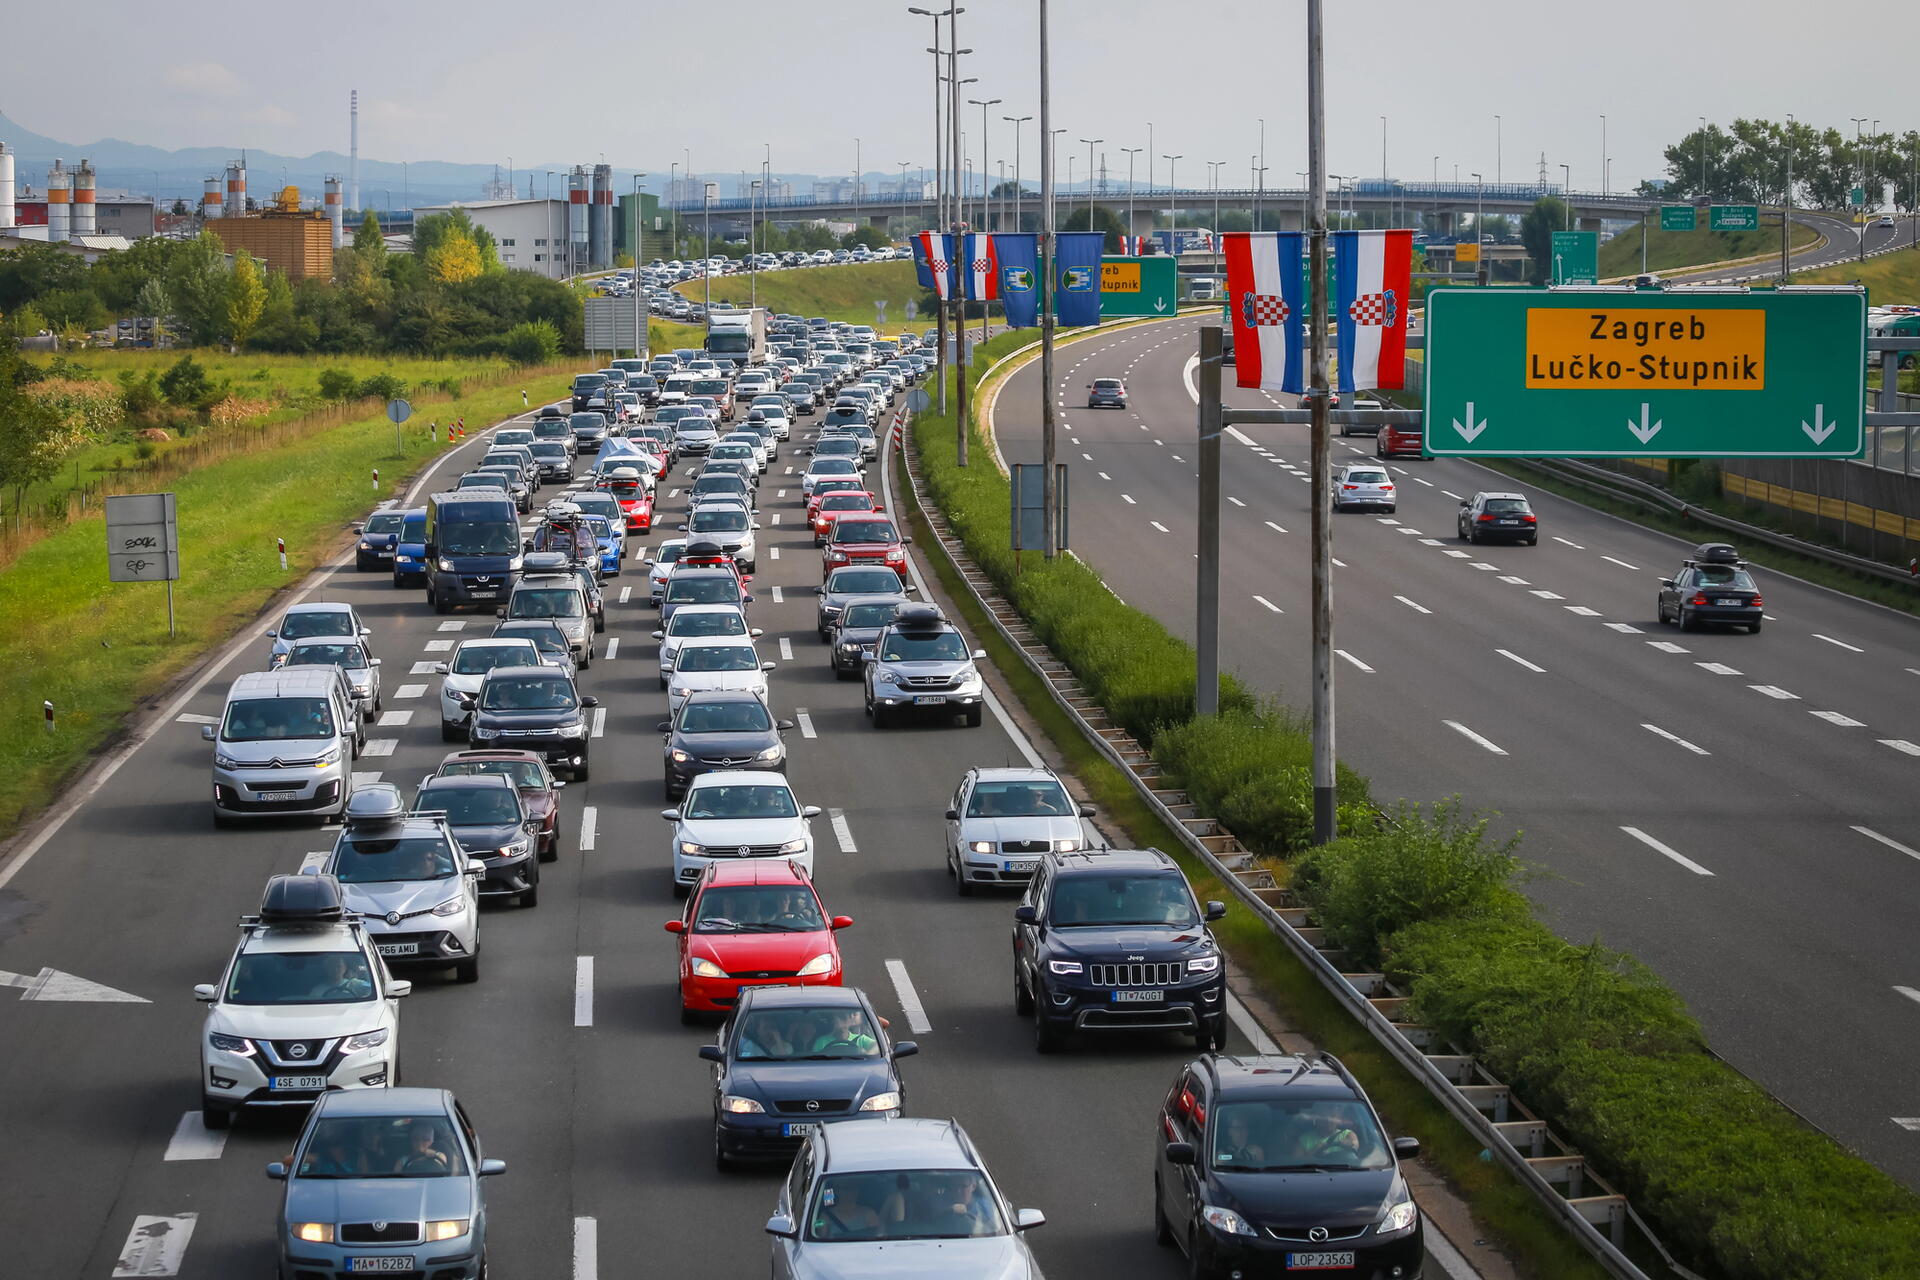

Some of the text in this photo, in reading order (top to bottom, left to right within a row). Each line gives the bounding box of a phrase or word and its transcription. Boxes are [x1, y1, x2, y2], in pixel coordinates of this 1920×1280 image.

[1101, 265, 1119, 275] reb
[1101, 280, 1138, 291] tupnik
[1590, 315, 1705, 347] Zagreb
[1532, 353, 1758, 386] Lučko-Stupnik
[379, 945, 396, 954] P66
[277, 1077, 322, 1087] 4SE 0791
[354, 1258, 412, 1270] MA 162BZ
[1293, 1253, 1353, 1266] LOP 23563
